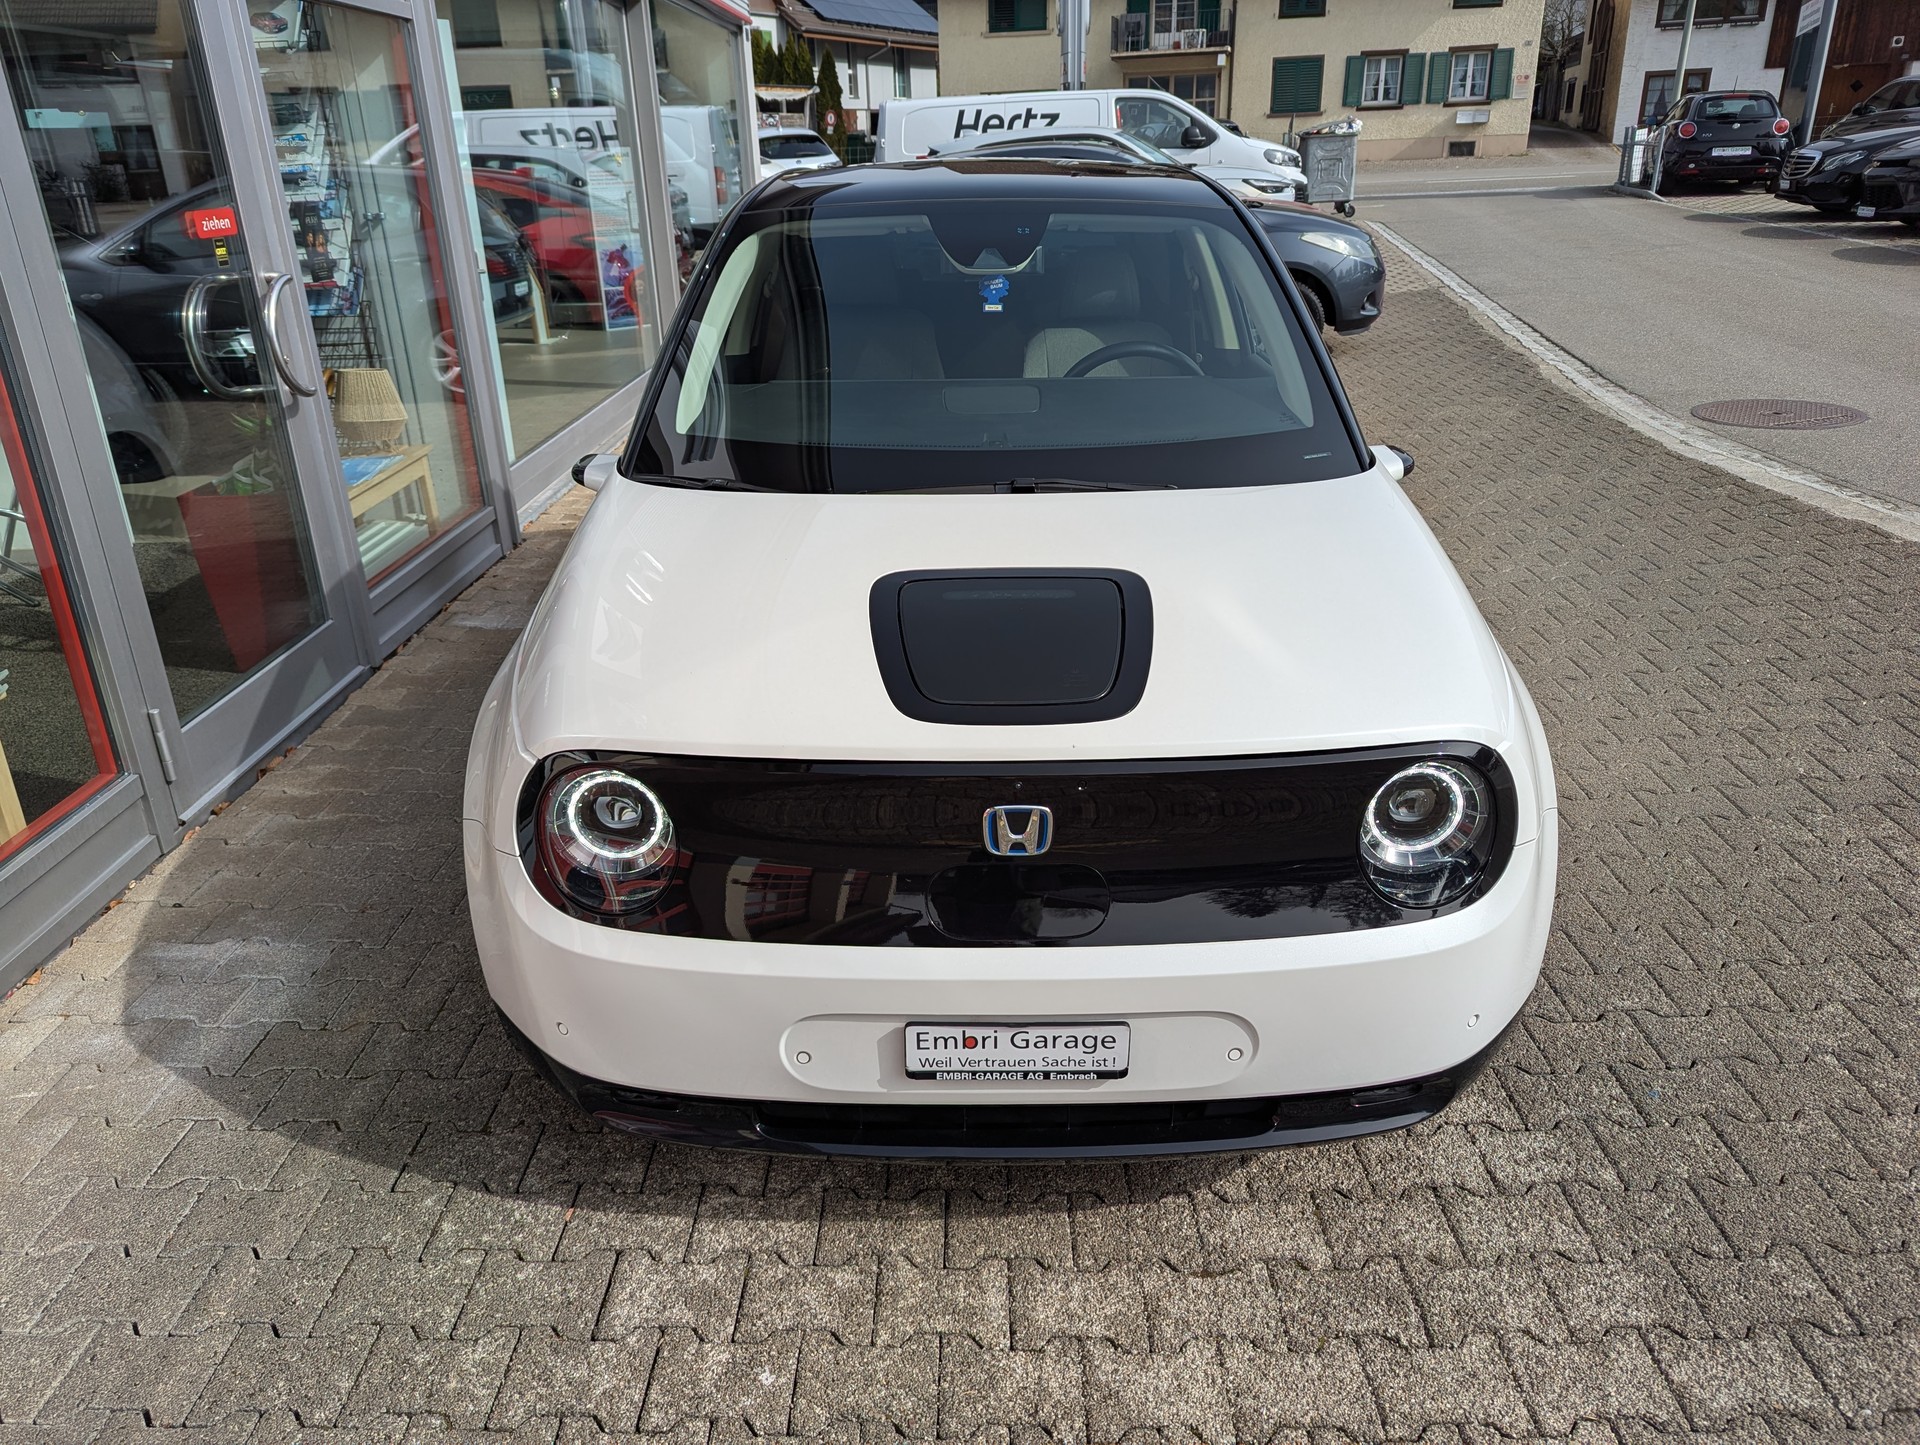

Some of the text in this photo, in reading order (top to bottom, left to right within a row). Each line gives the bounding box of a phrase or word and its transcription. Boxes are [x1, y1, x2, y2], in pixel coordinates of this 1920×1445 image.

[953, 107, 1061, 140] Hertz
[202, 216, 231, 231] ziehen
[916, 1030, 1117, 1054] Embri Garage
[918, 1057, 952, 1068] Weil
[957, 1057, 1036, 1068] Vertrauen
[1042, 1056, 1086, 1067] Sache
[936, 1072, 1097, 1081] EMBRI-GARAGE AG Embrach
